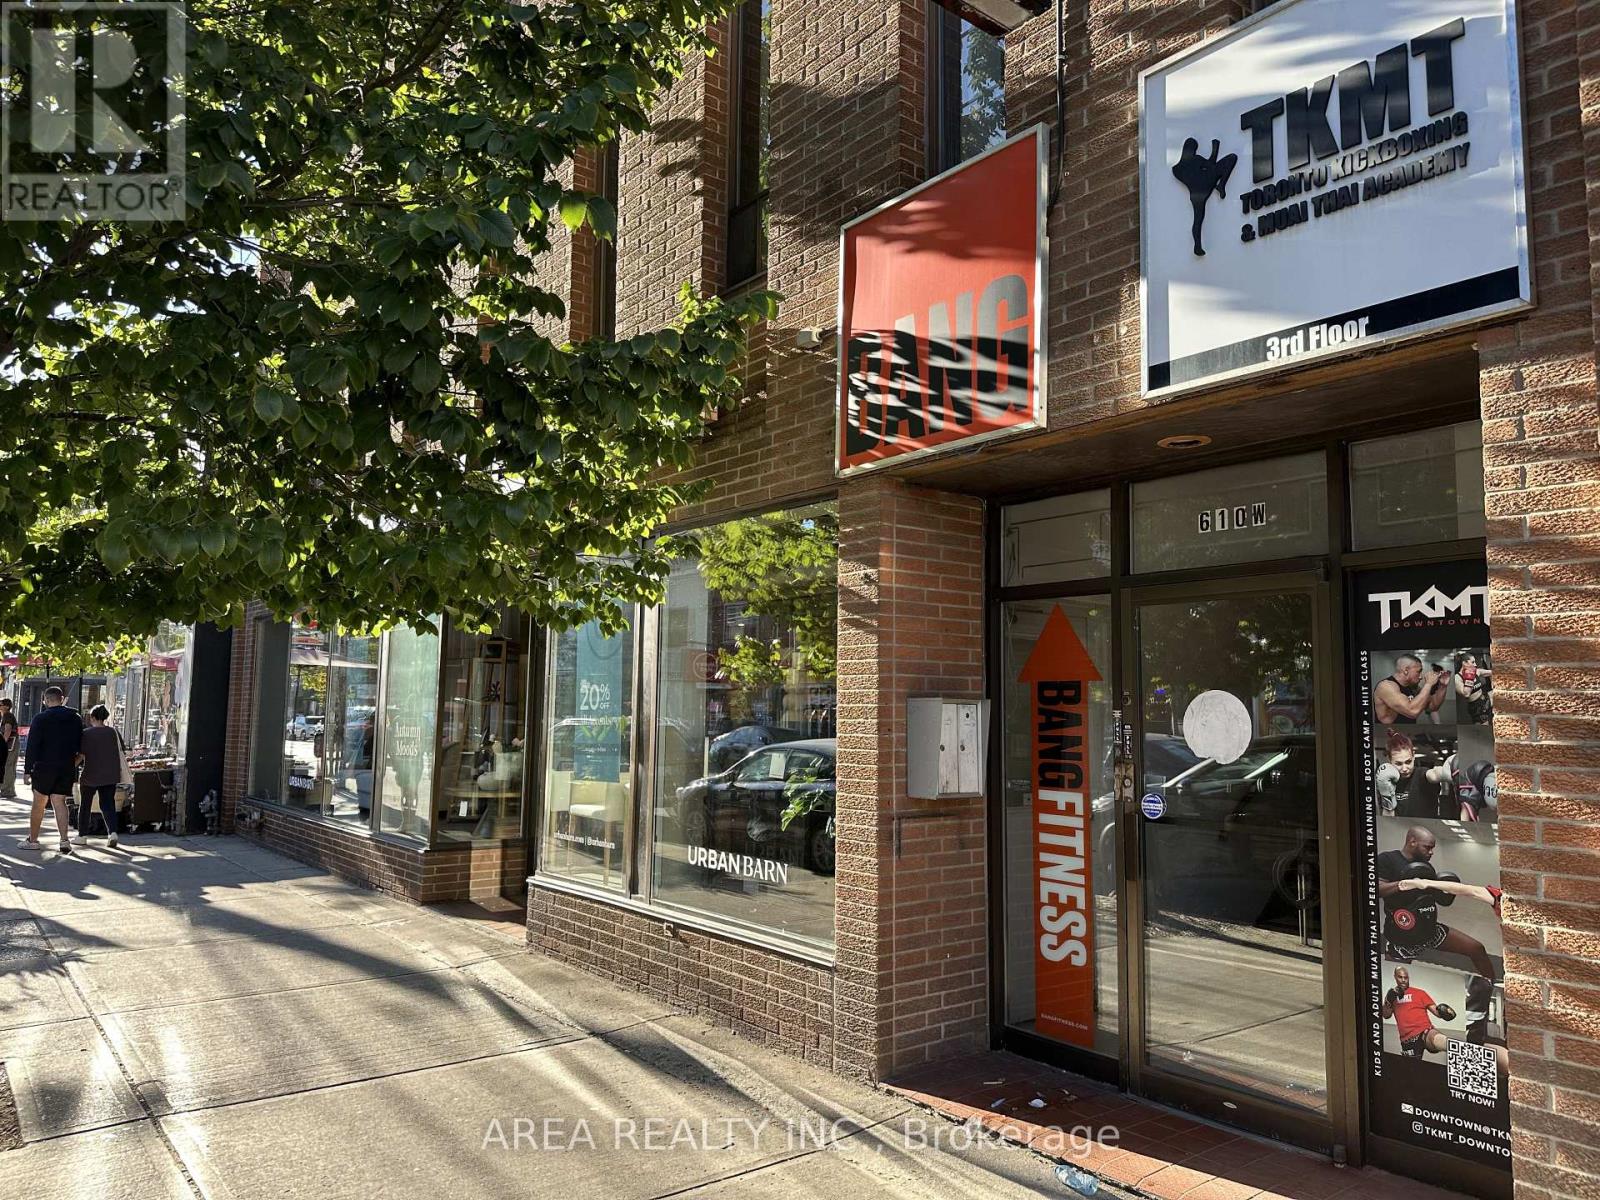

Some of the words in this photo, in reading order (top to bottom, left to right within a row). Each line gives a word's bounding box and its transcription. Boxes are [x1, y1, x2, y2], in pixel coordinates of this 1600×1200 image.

[1241, 17, 1465, 184] TKMT
[1240, 164, 1327, 214] TORONTO
[1327, 111, 1468, 182] KICKBOXING
[1241, 223, 1255, 242] &
[1258, 200, 1309, 237] MUAI
[1311, 182, 1359, 217] THAI
[1362, 142, 1470, 201] ACADEMY
[1266, 329, 1304, 361] 3rd
[1309, 316, 1369, 351] Floor
[846, 274, 1028, 456] BANG
[1199, 502, 1266, 532] 610W
[1393, 618, 1481, 628] DOWNTOWN
[1360, 650, 1368, 681] CLASS
[1362, 720, 1371, 749] CAMP
[1363, 753, 1372, 781] BOOT
[1366, 796, 1374, 847] TRAINING
[688, 845, 740, 875] URBAN
[743, 855, 789, 885] BARN
[1367, 852, 1376, 906] PERSONAL
[1369, 920, 1378, 945] THAI
[1370, 949, 1379, 980] MUAY
[1371, 984, 1380, 1018] ADULT
[1372, 1023, 1380, 1046] AND
[1373, 1050, 1382, 1077] KIDS
[1450, 1089, 1466, 1100] TRY
[1468, 1094, 1495, 1108] NOW!
